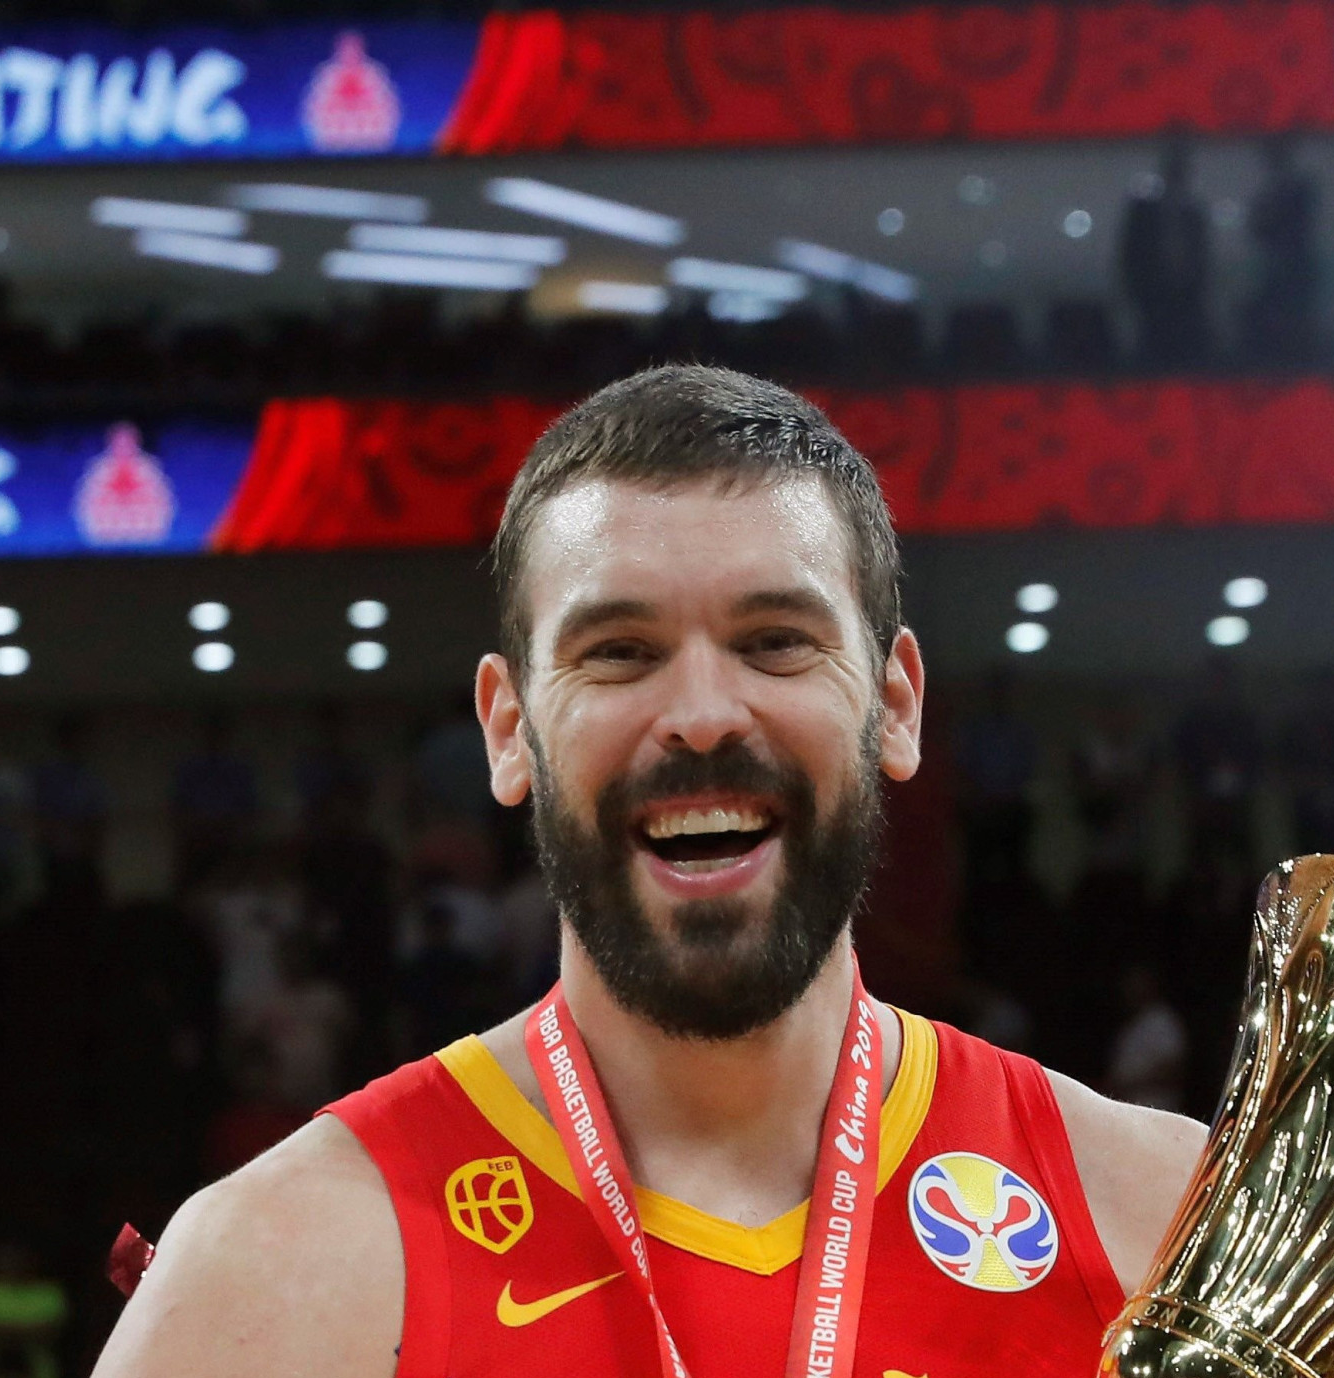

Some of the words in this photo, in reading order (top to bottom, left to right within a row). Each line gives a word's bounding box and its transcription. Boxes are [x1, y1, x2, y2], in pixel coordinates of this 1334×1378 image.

[539, 1002, 562, 1049] FIBA
[851, 1000, 877, 1070] 2019
[548, 1045, 604, 1168] BASKETBALL
[834, 1075, 869, 1166] China
[488, 1160, 514, 1173] FEB
[592, 1161, 636, 1238] WORLD
[831, 1170, 859, 1212] CUP
[819, 1217, 853, 1291] WORLD
